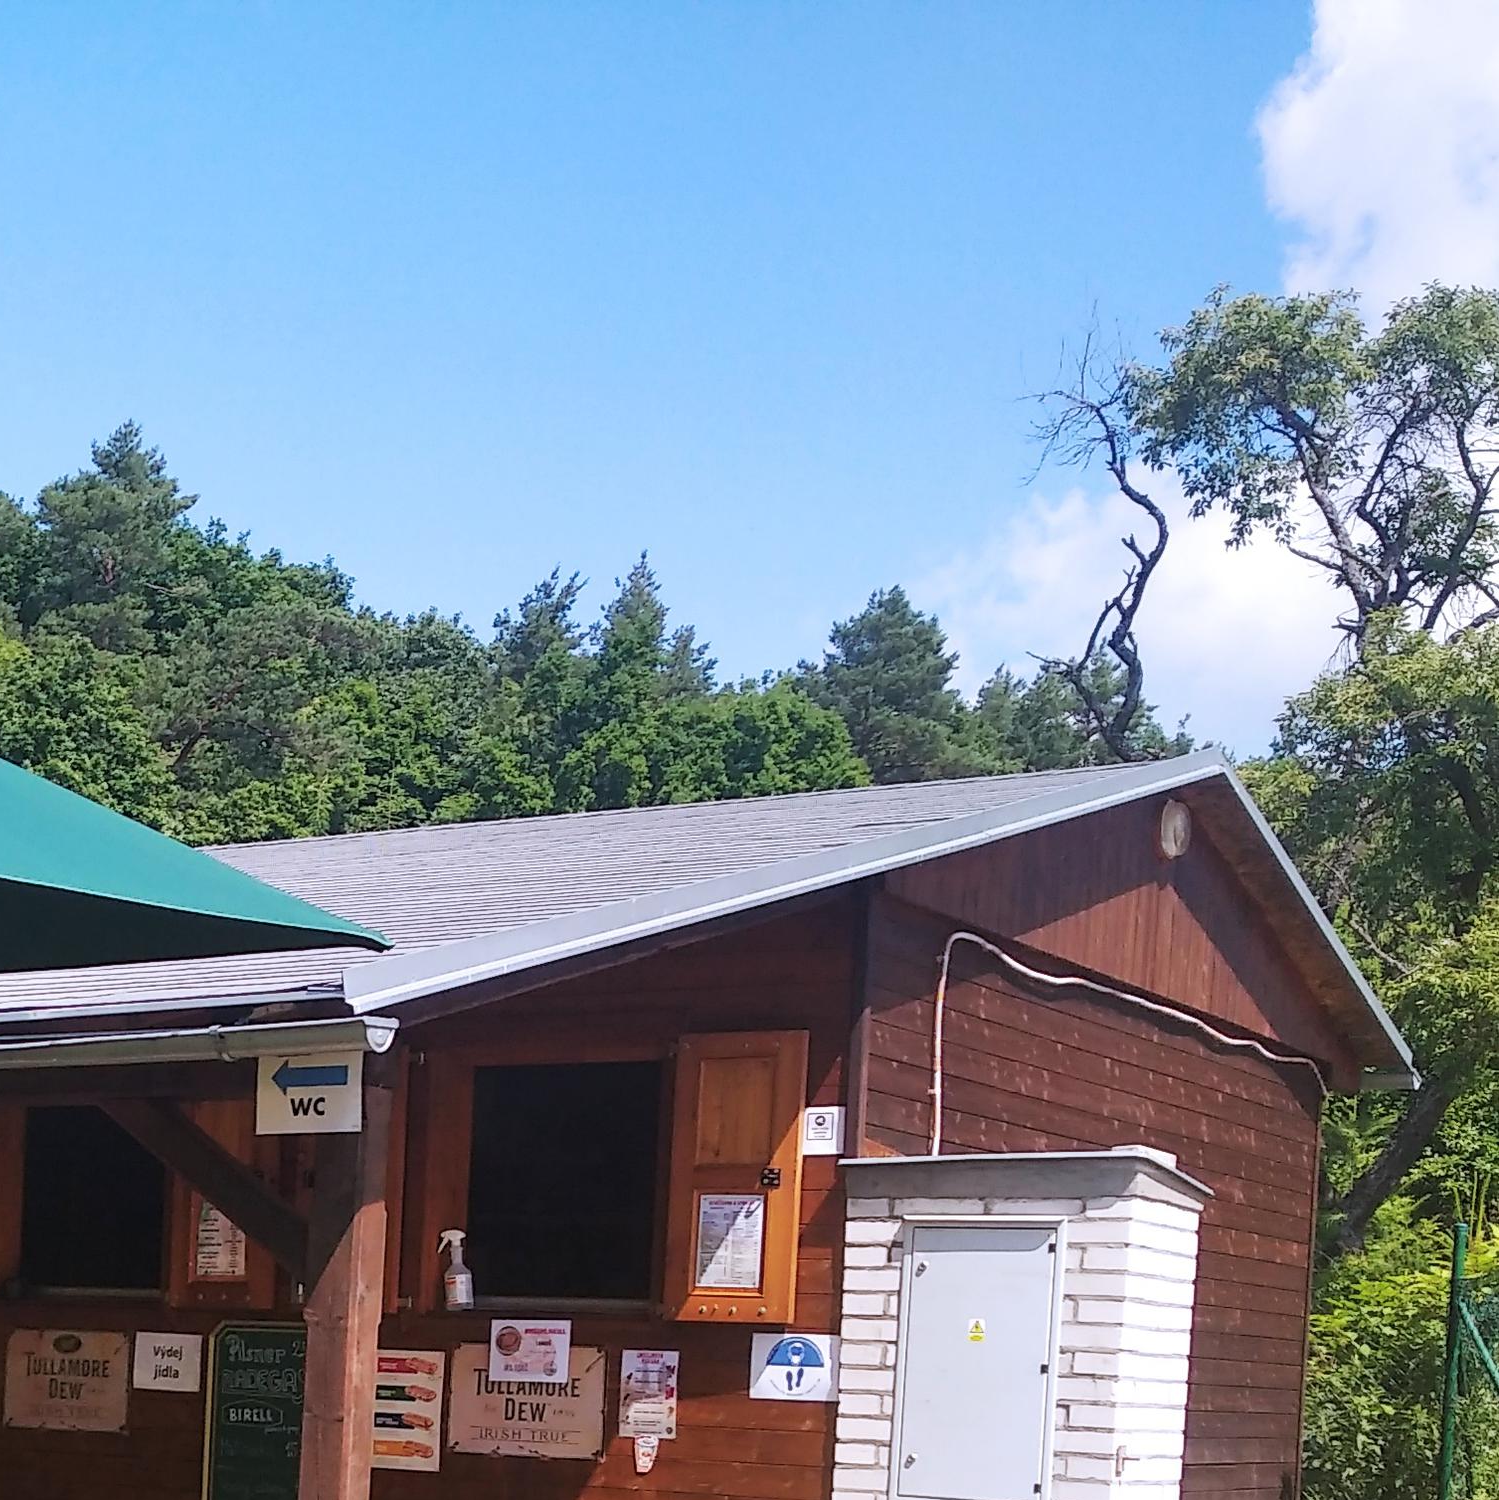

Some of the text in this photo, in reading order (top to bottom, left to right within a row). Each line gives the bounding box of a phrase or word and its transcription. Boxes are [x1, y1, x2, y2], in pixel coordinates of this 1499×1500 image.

[289, 1097, 326, 1117] WC
[153, 1344, 183, 1361] Výdej
[25, 1352, 110, 1378] TULLAMORE
[153, 1364, 180, 1380] jídla
[48, 1378, 84, 1401] DEW
[229, 1407, 273, 1422] BIRELL
[480, 1426, 569, 1443] IRISH TRUE
